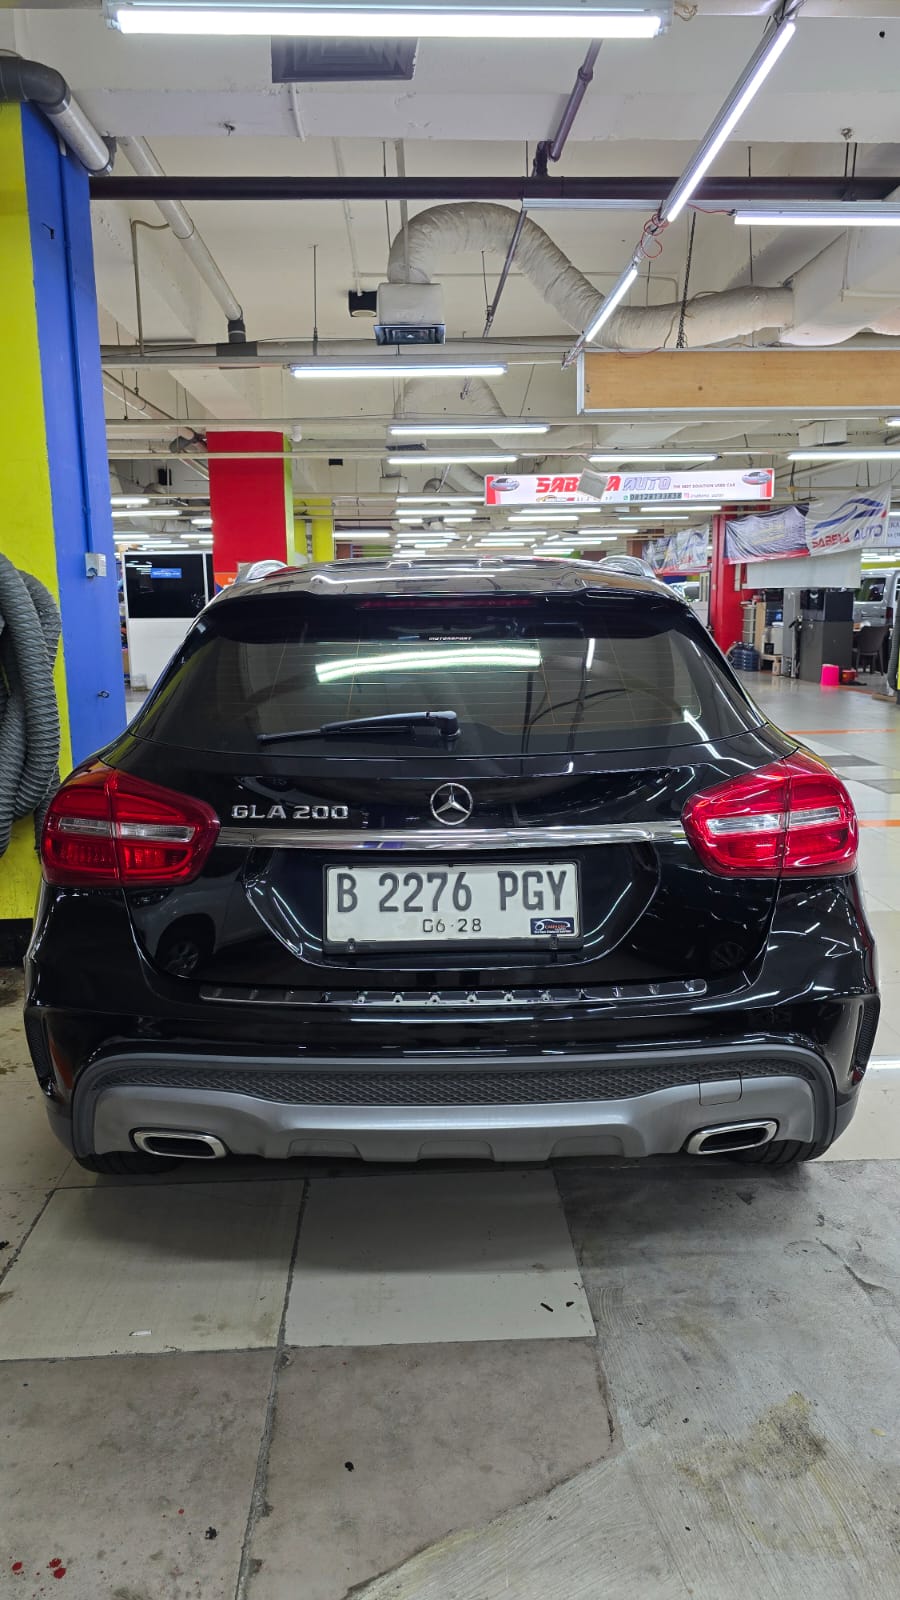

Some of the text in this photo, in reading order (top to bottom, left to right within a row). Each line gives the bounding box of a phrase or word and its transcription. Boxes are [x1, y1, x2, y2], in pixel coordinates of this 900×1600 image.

[536, 476, 672, 493] SABA AUTO
[854, 524, 883, 540] AUTO
[231, 804, 349, 819] GLA 200
[336, 870, 567, 913] B 2276 PGY
